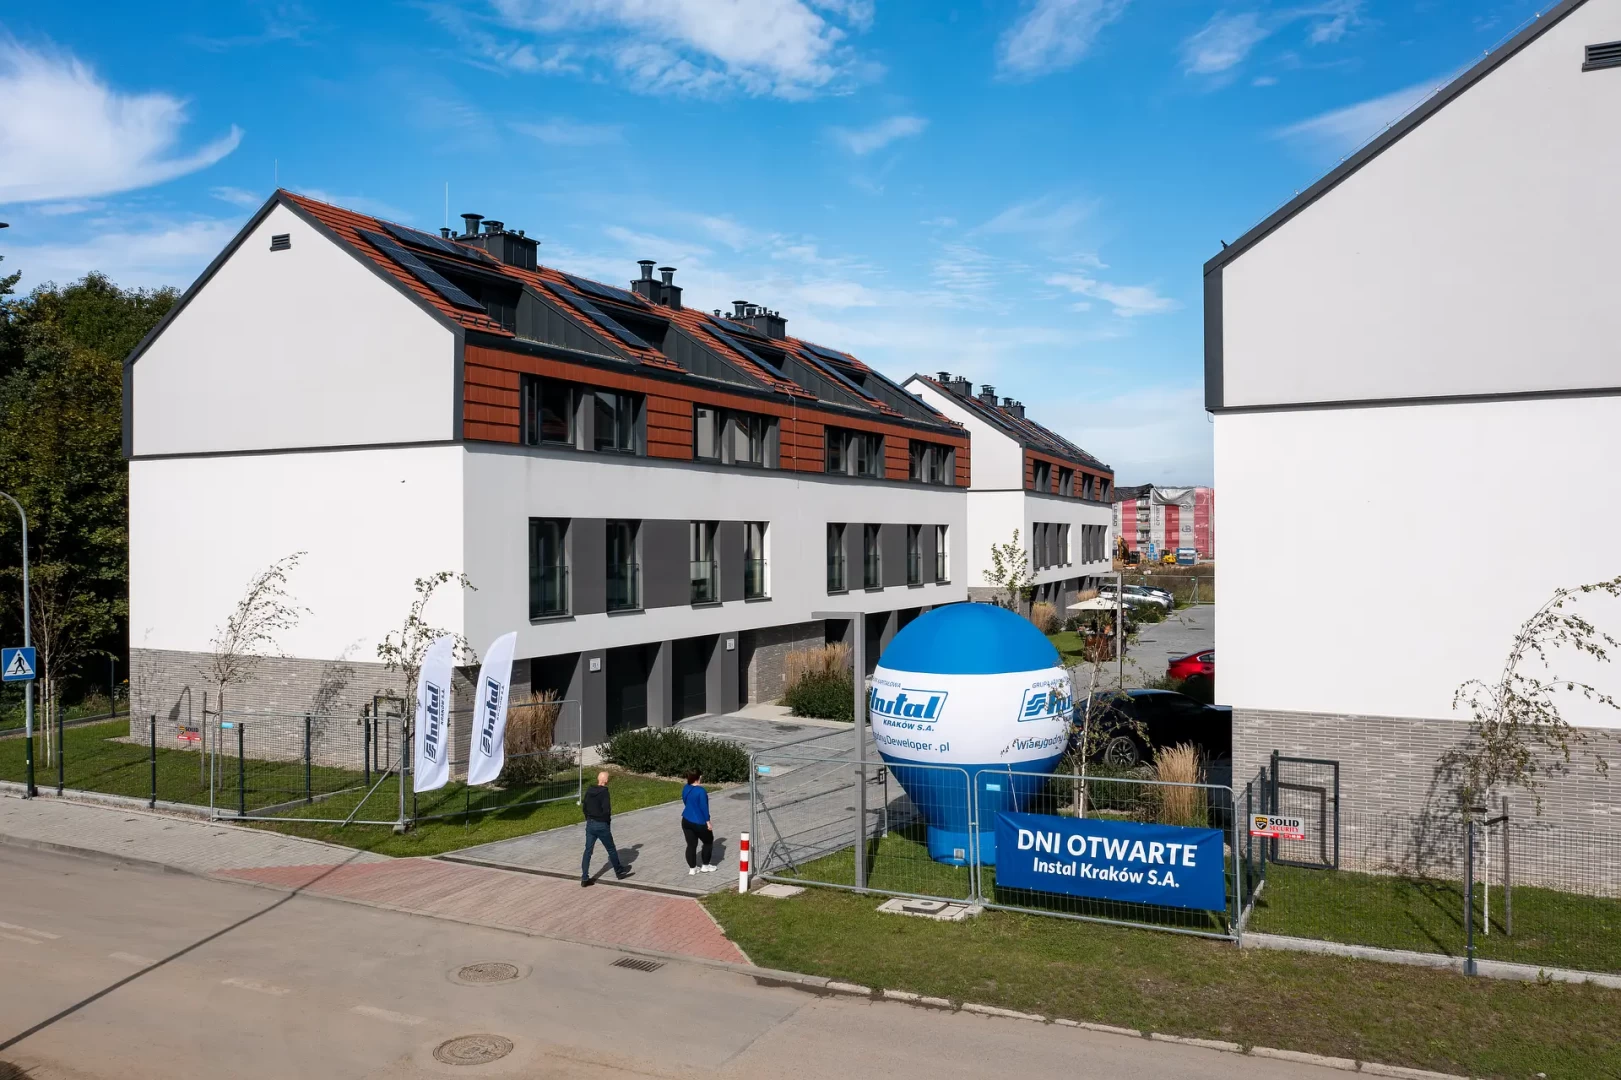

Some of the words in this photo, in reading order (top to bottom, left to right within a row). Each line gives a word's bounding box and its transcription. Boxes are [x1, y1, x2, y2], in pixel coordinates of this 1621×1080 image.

[426, 685, 439, 744] Instal
[483, 680, 499, 738] Instal
[870, 687, 941, 719] Instal
[883, 719, 915, 730] KRAKÓW
[917, 724, 935, 732] S.A.
[1269, 818, 1299, 827] SOLID
[1269, 825, 1299, 833] SECURITY
[1017, 828, 1061, 855] DNI
[1066, 834, 1198, 868] OTWARTE
[1033, 857, 1076, 877] Instal
[1080, 862, 1144, 884] Kraków
[1147, 870, 1180, 889] S.A.
